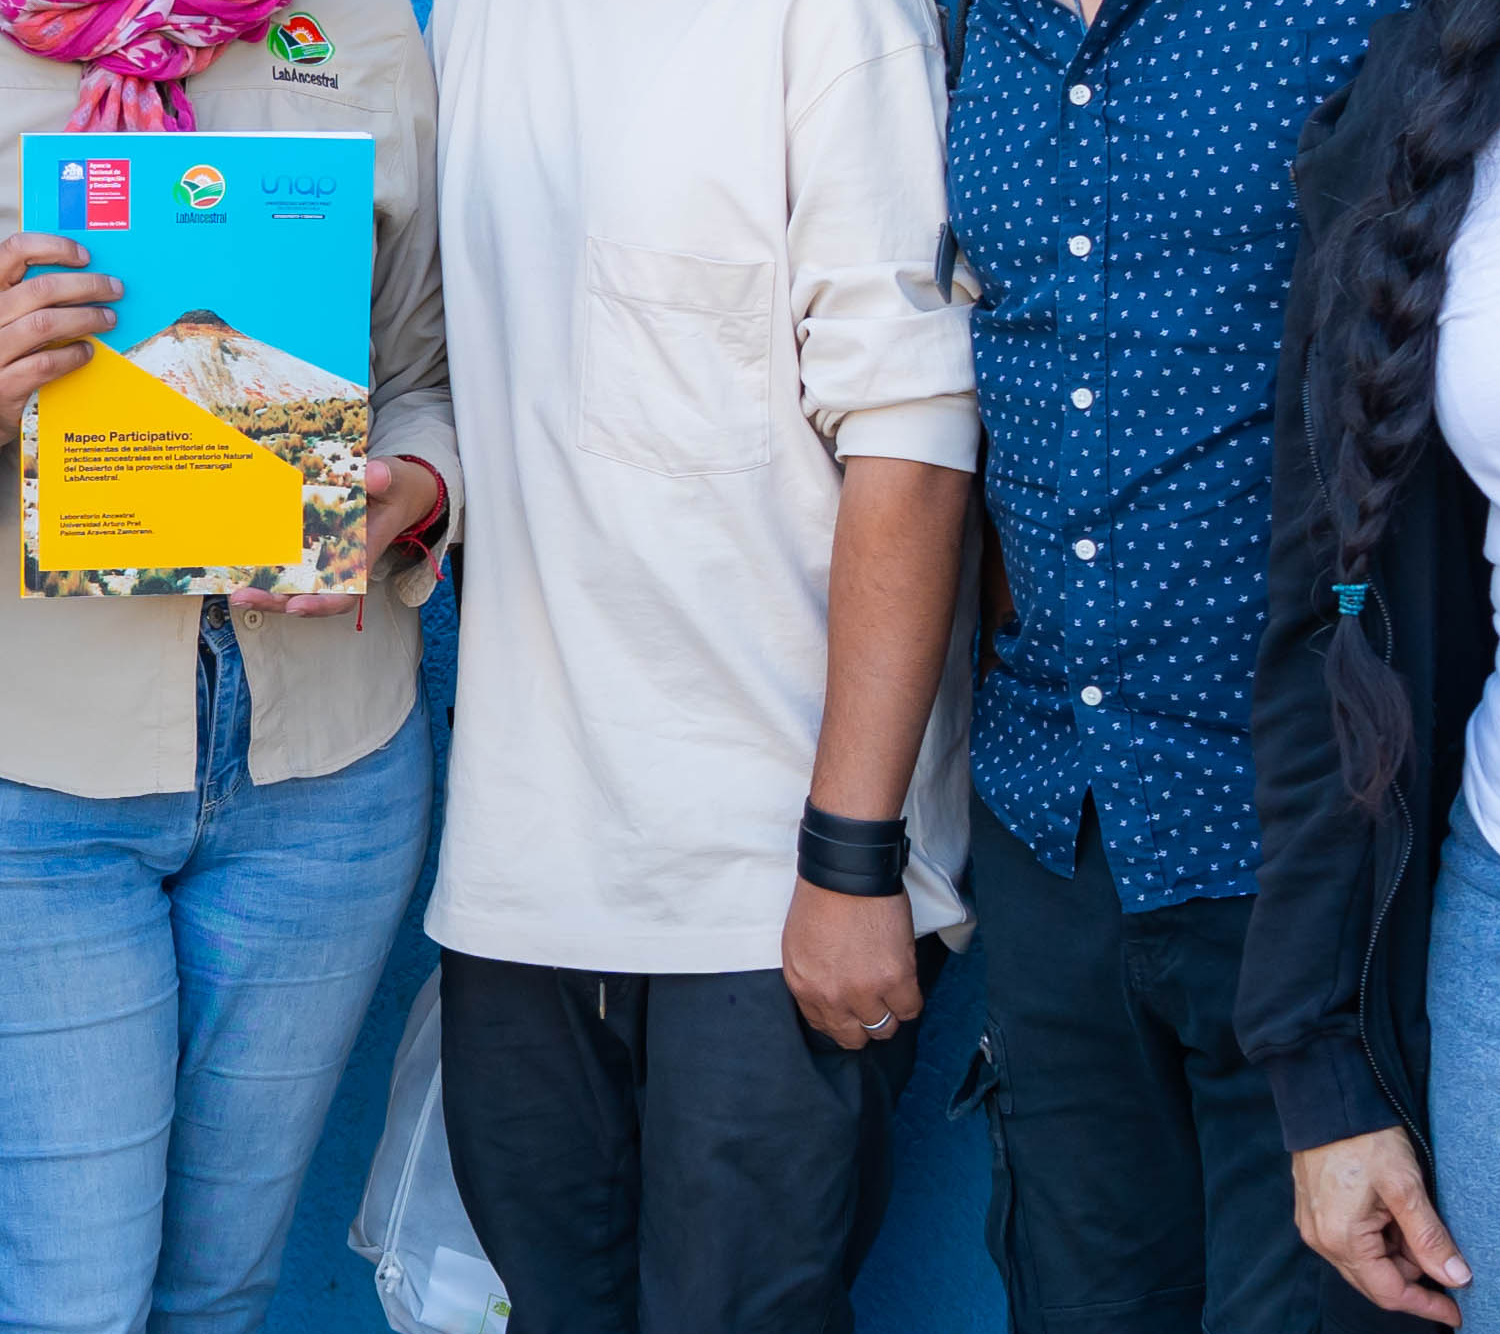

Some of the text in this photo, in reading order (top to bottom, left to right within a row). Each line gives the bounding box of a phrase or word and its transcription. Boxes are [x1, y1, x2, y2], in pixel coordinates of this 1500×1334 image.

[272, 65, 339, 89] LabAncestral
[176, 212, 227, 224] LabAncestral
[64, 431, 193, 445] Mapeo Participativo:
[135, 464, 173, 472] provincia
